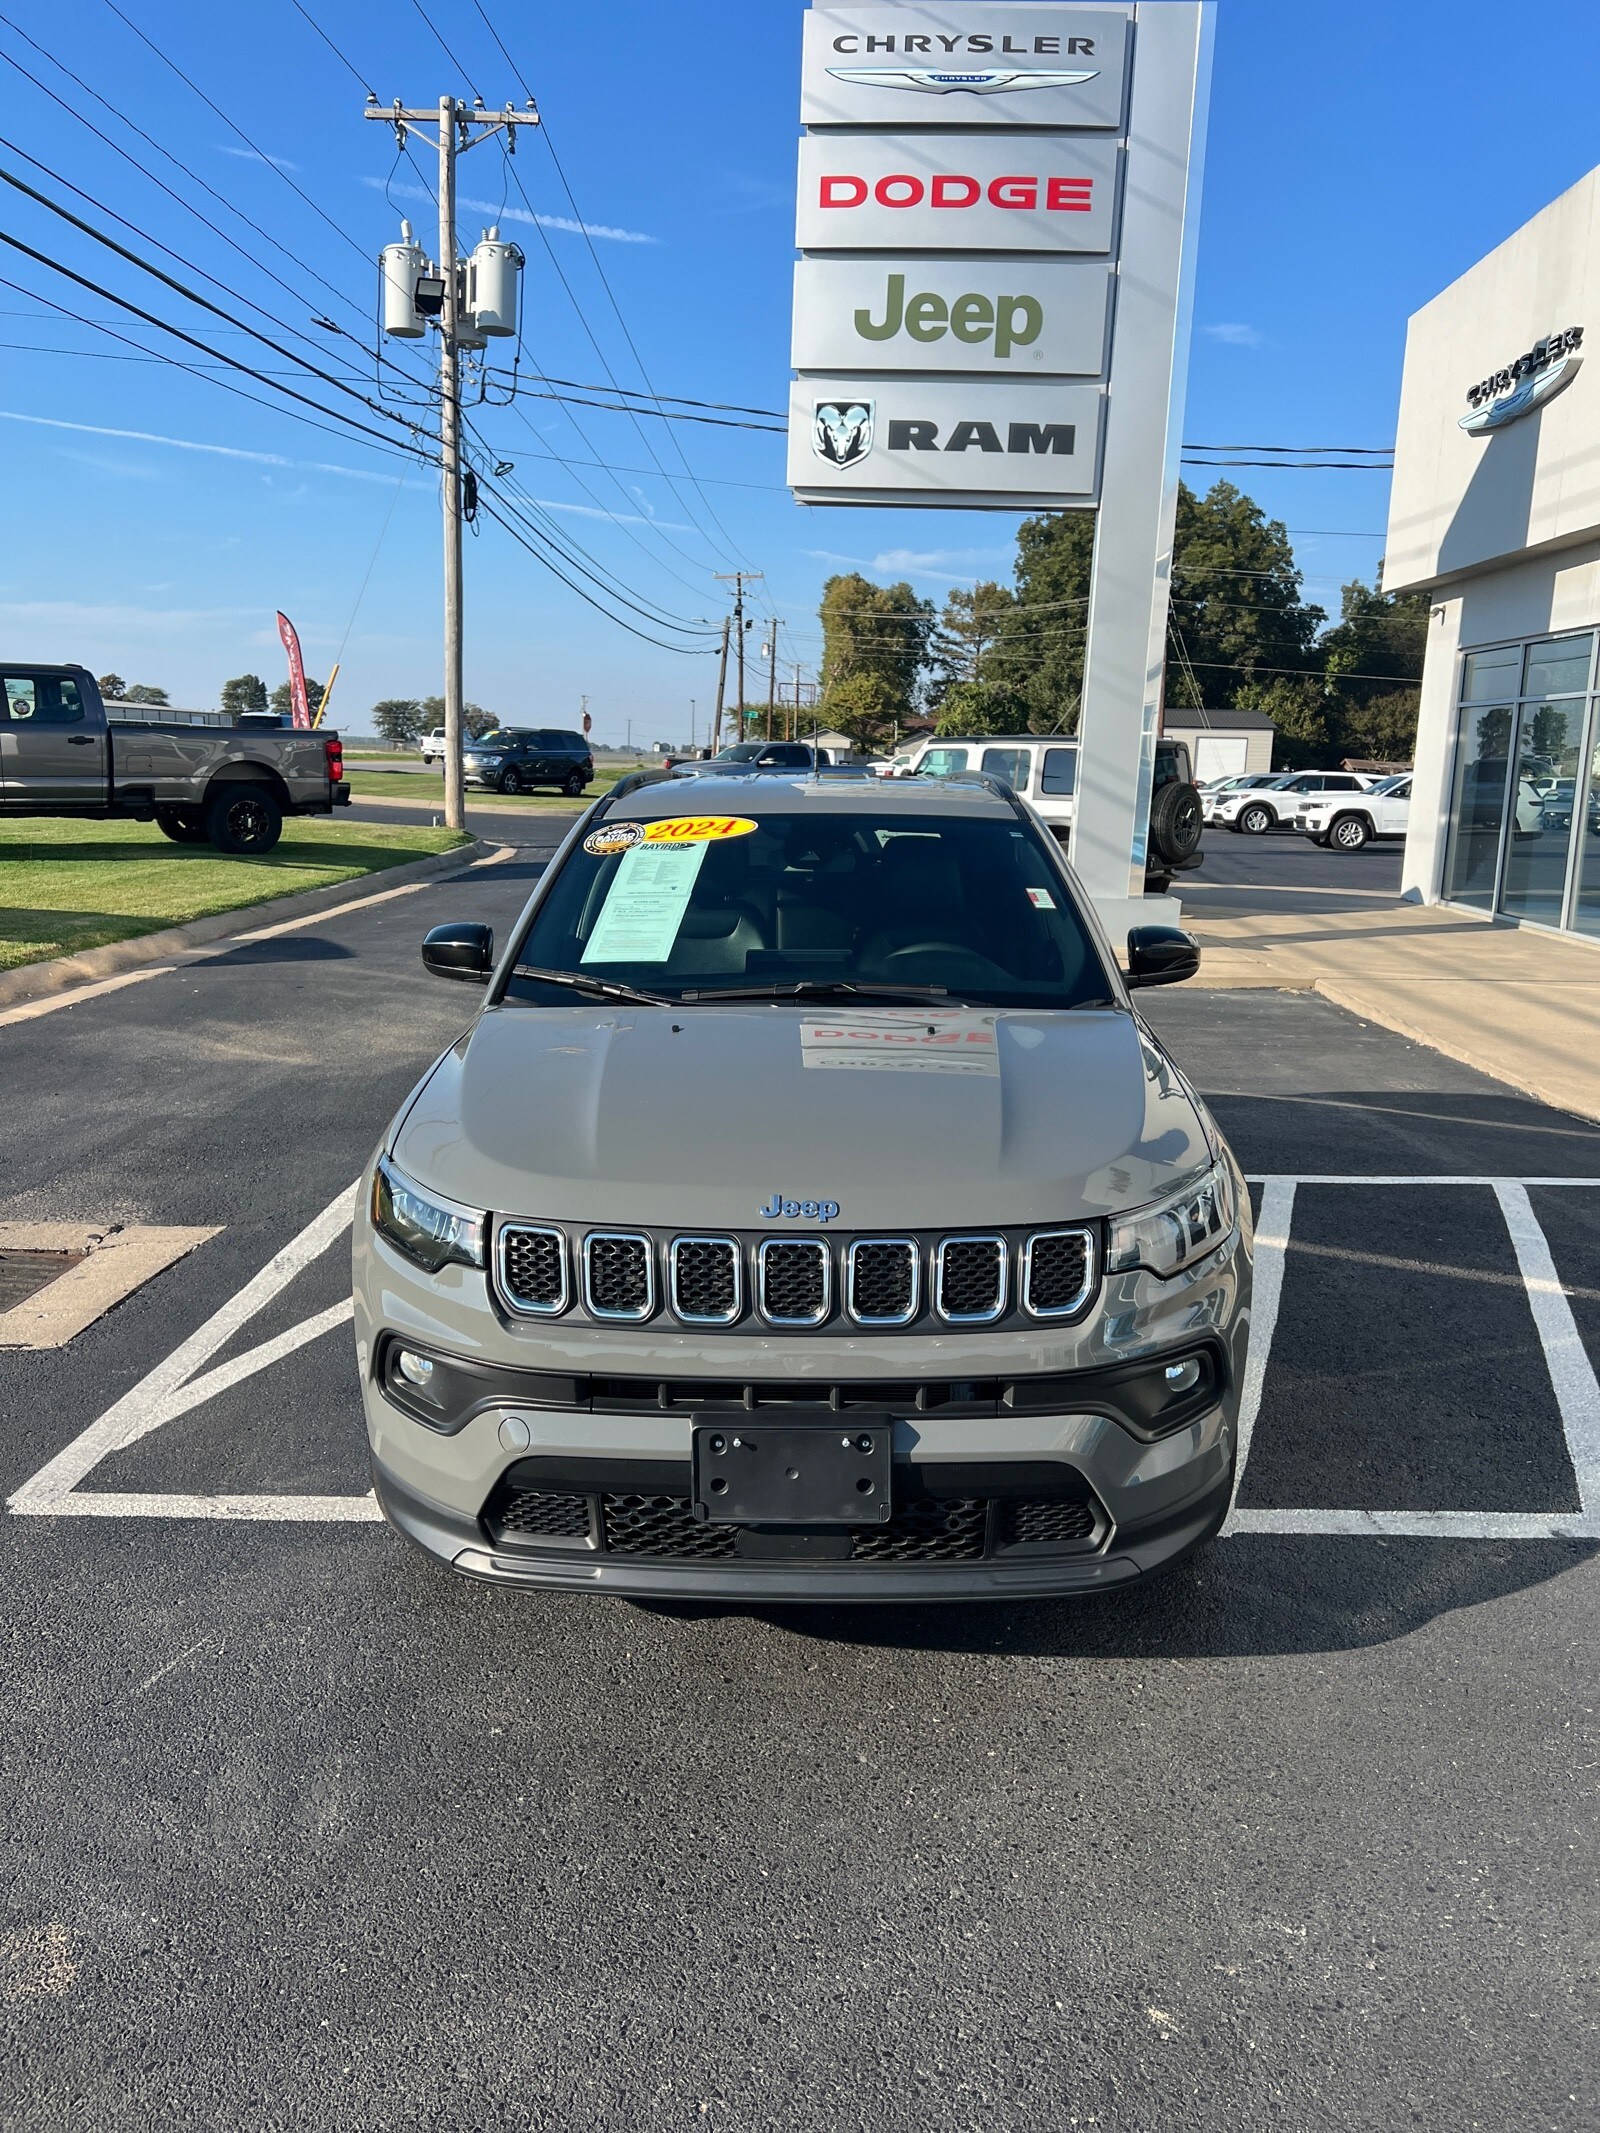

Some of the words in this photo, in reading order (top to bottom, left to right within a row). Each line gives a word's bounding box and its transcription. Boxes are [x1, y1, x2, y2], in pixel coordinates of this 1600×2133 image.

[832, 34, 1096, 56] CHRYSLER
[819, 175, 1094, 212] DODGE
[854, 274, 1043, 358] Jeep
[1466, 327, 1584, 408] CHRYSLER
[887, 419, 1076, 455] RAM
[648, 820, 737, 839] 2024
[640, 842, 681, 851] BAYIRD
[760, 1194, 840, 1223] Jeep
